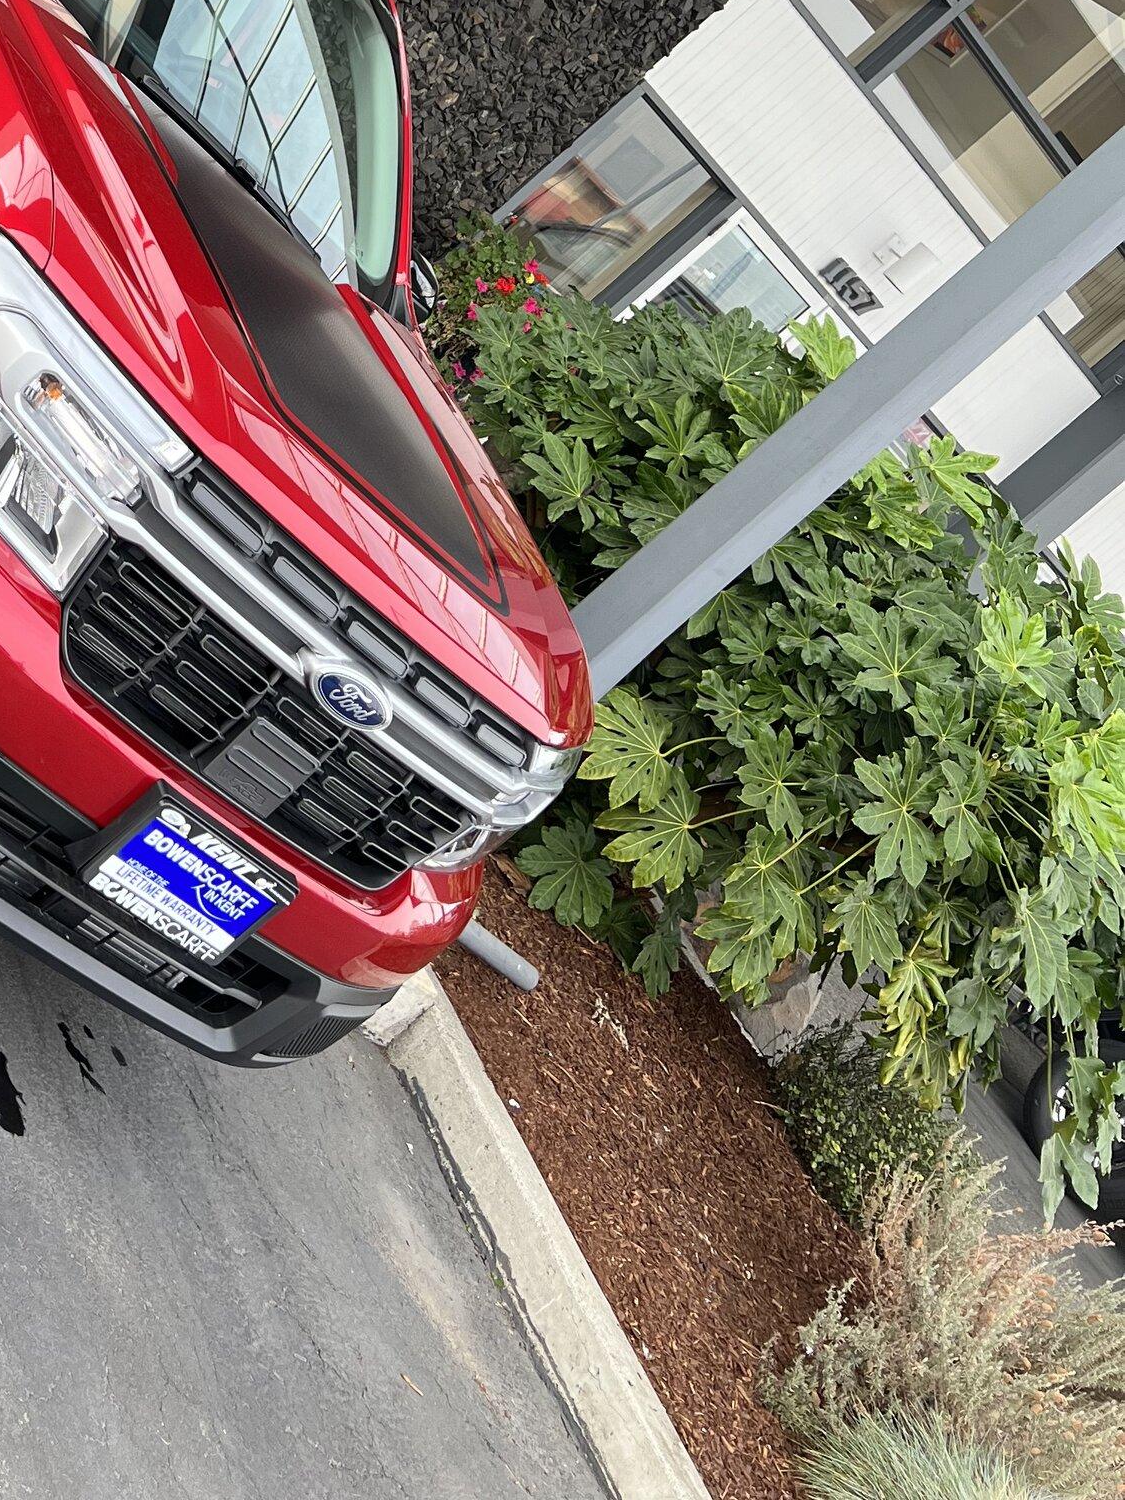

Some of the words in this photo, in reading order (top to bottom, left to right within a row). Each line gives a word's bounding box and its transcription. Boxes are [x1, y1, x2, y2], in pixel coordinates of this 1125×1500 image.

[818, 257, 884, 316] 1157
[329, 683, 377, 721] Ford
[127, 857, 149, 874] HOME
[143, 829, 259, 911] BOWENSCARFF
[189, 832, 259, 877] KENT
[116, 865, 162, 898] LIFETIME
[161, 896, 216, 936] WARRANTY
[214, 898, 246, 920] KENT
